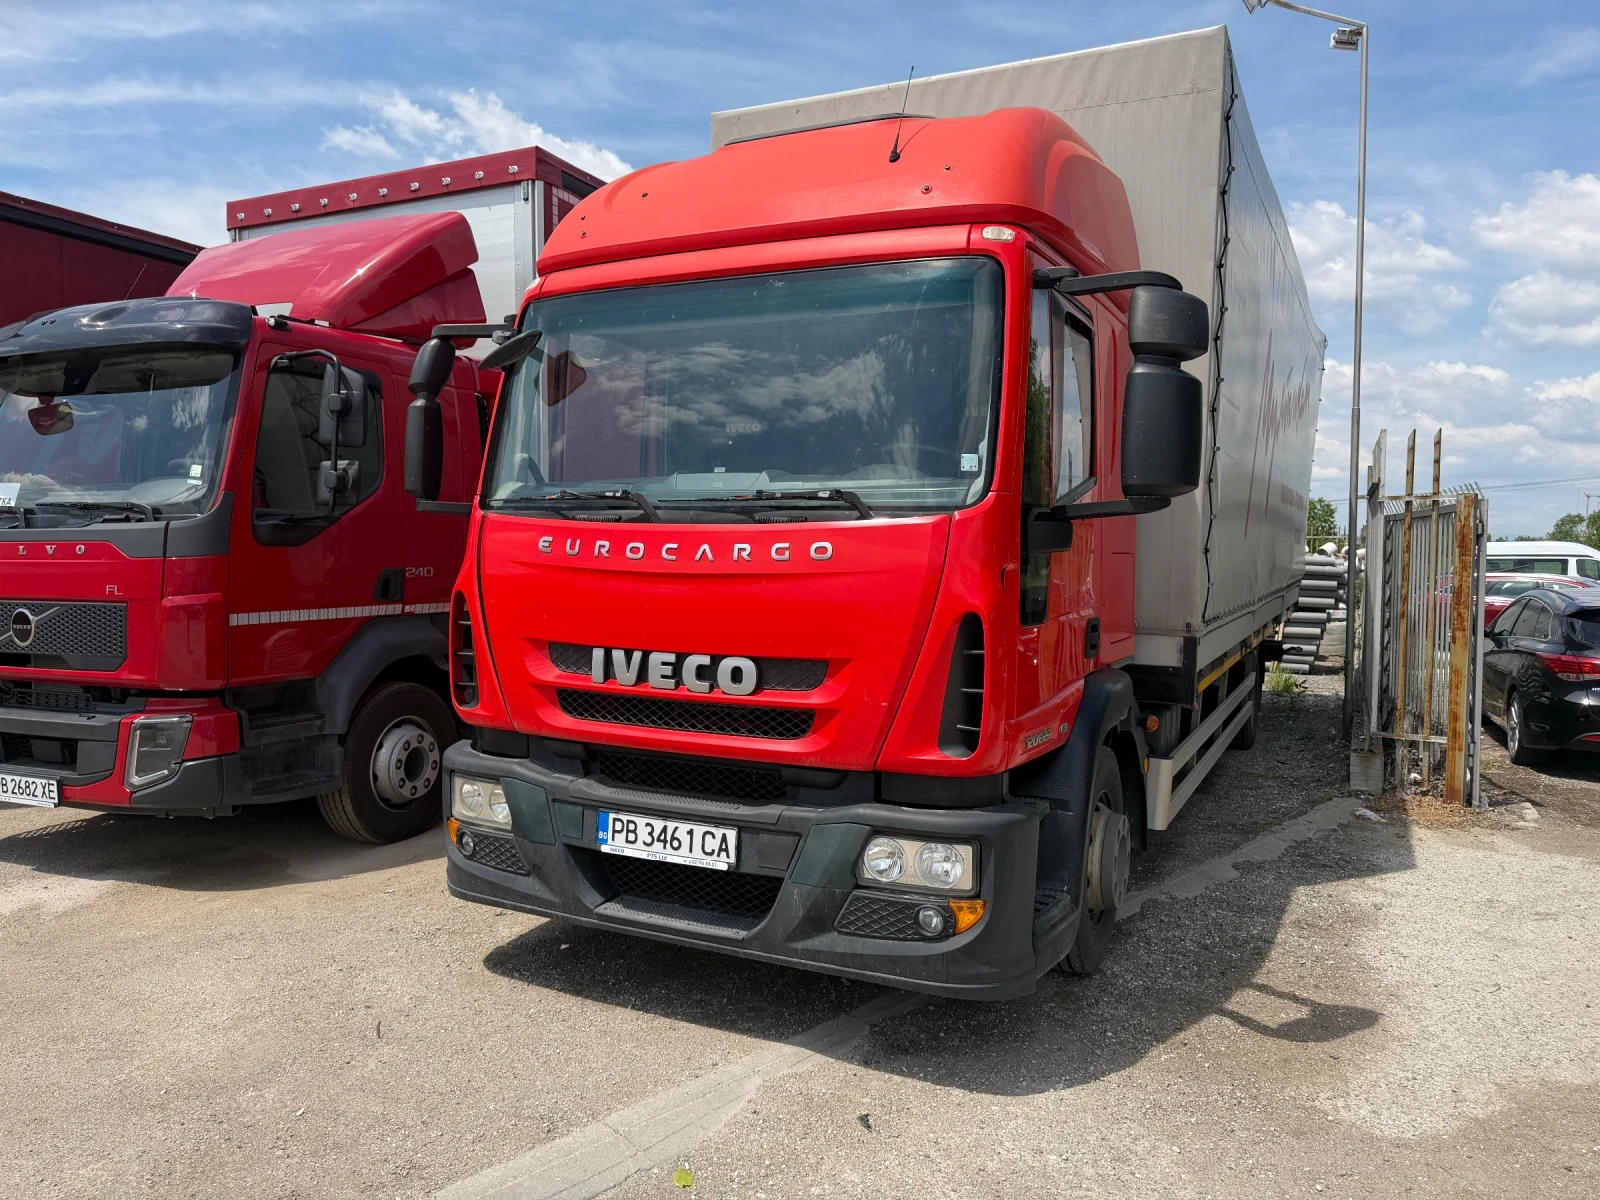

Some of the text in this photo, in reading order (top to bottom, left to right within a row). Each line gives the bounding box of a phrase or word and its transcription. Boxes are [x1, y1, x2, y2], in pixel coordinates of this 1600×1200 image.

[726, 423, 761, 433] IVECO
[538, 535, 834, 562] EUROCARGO
[405, 566, 434, 578] 240
[105, 585, 124, 596] FL
[591, 647, 760, 697] IVECO
[10, 778, 39, 798] 2682
[40, 781, 56, 800] XE
[598, 830, 608, 840] BG
[611, 817, 731, 859] PB 3461 CA
